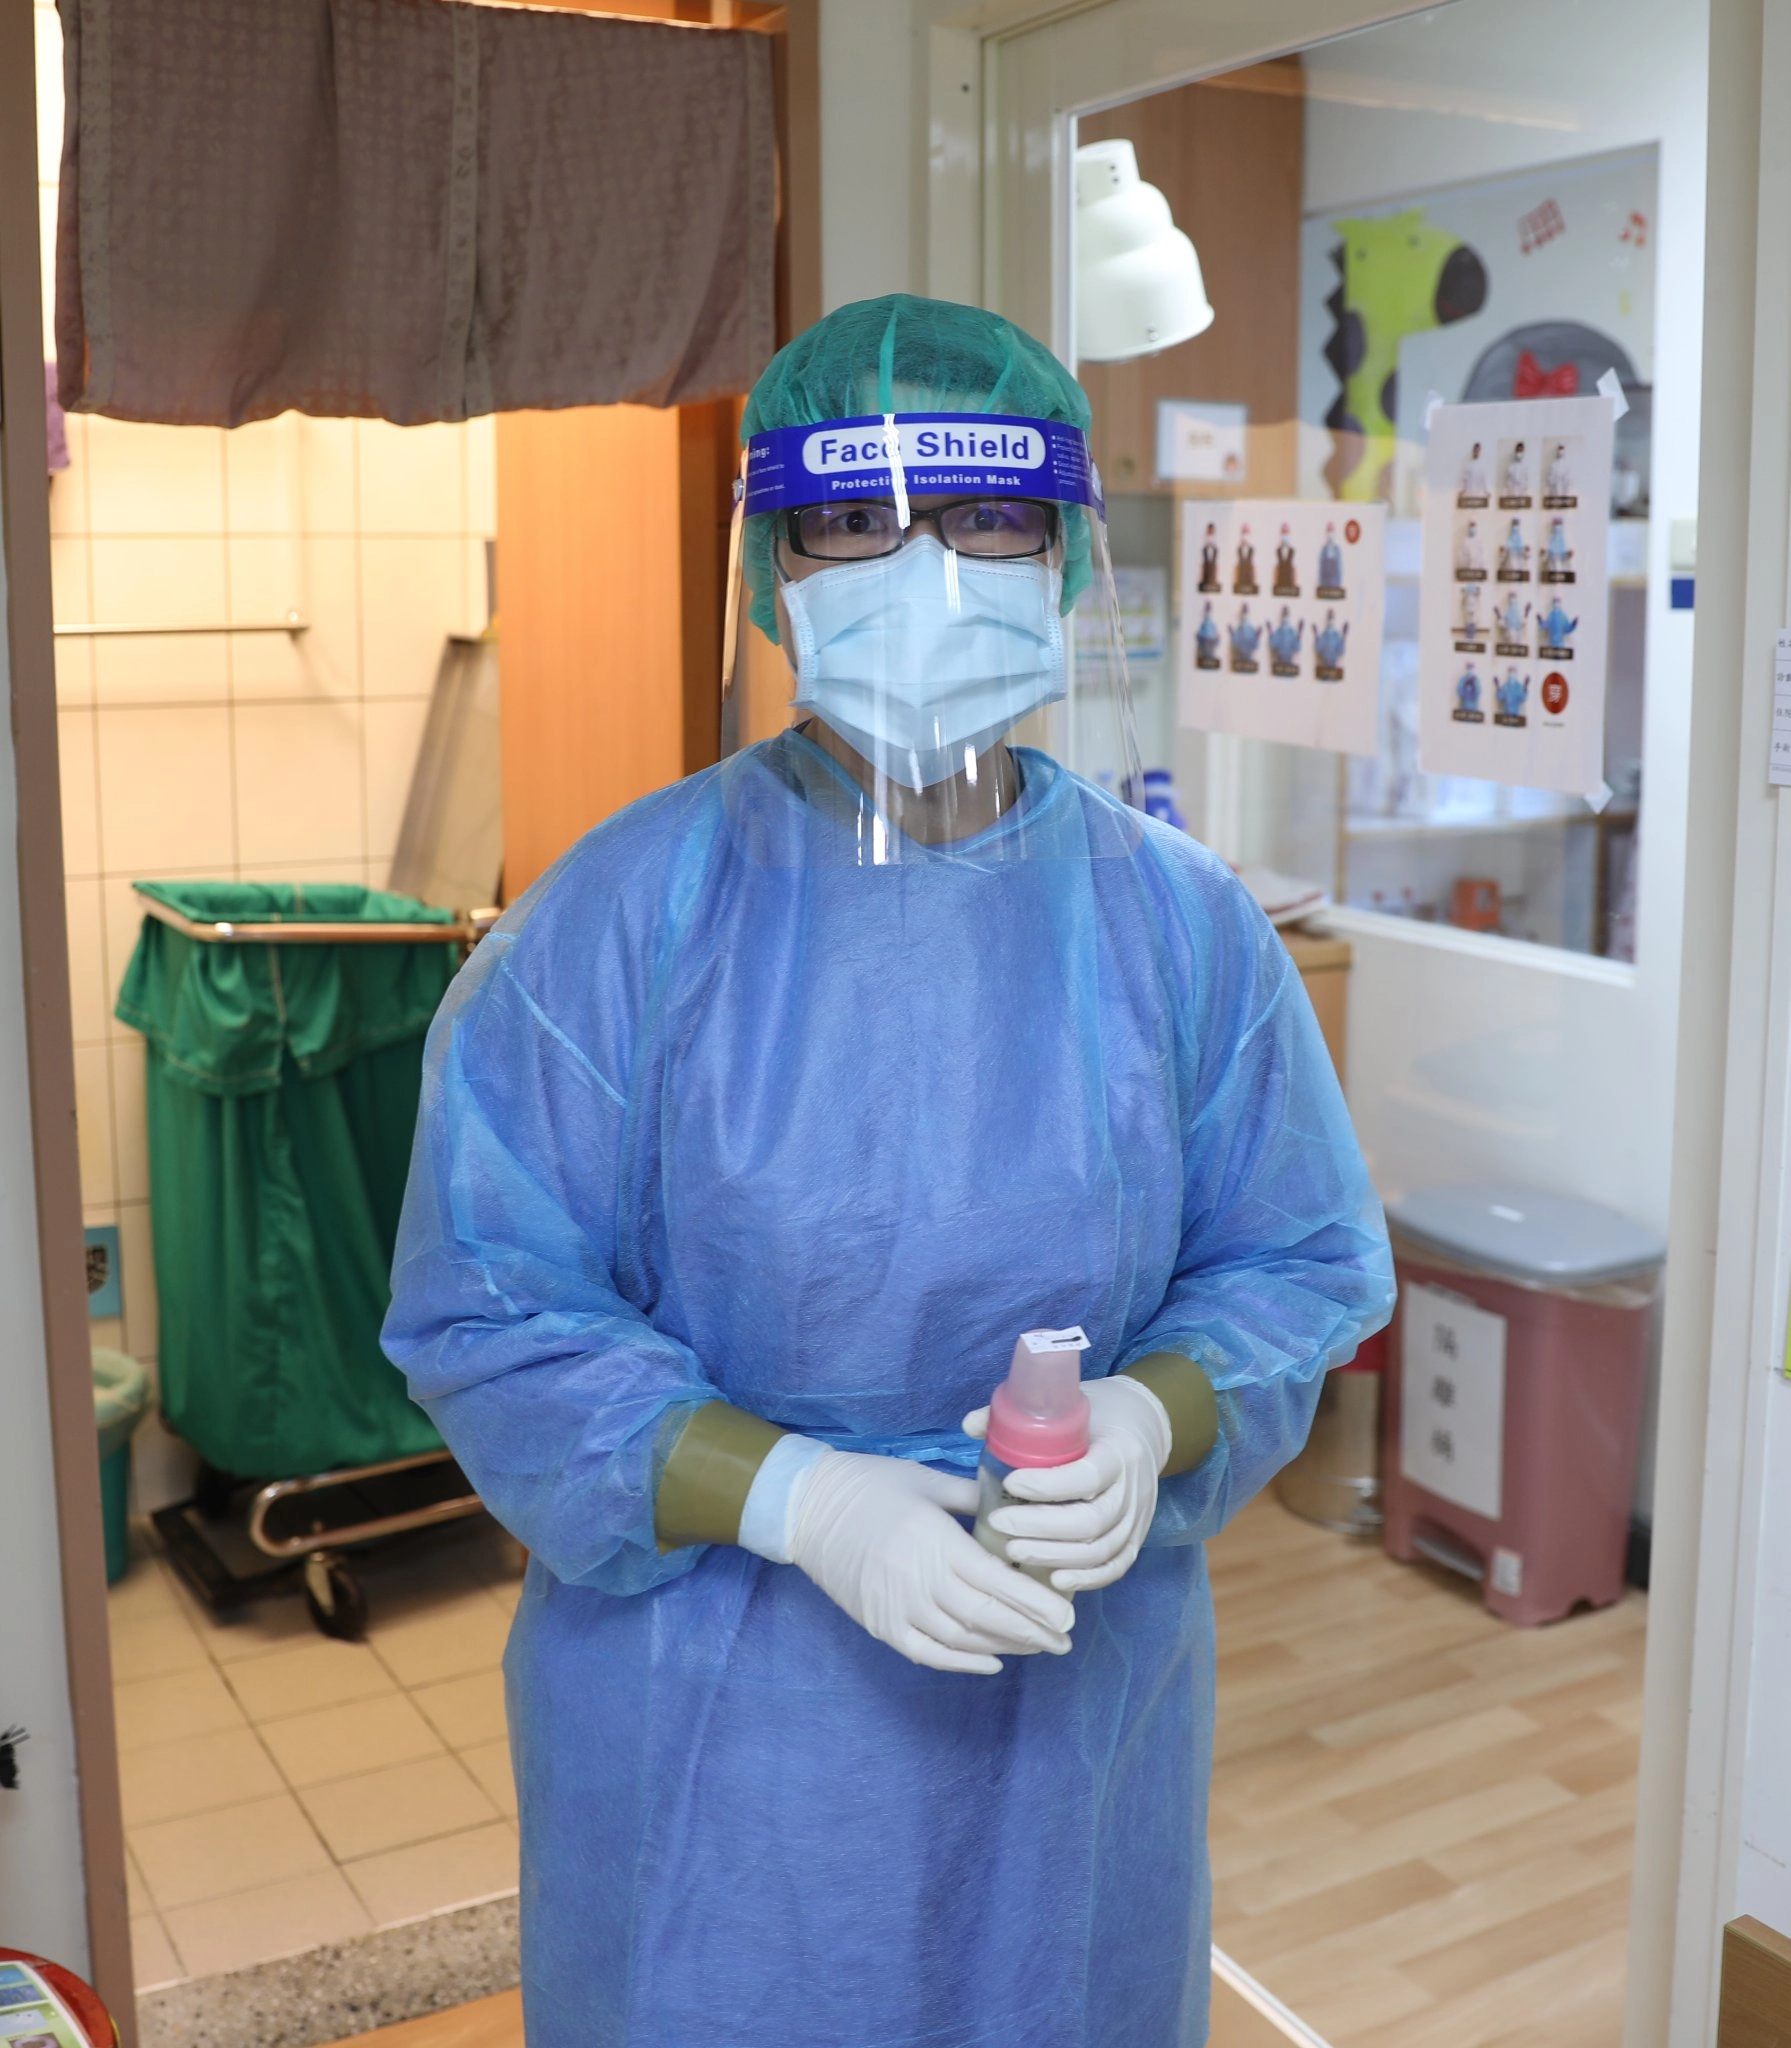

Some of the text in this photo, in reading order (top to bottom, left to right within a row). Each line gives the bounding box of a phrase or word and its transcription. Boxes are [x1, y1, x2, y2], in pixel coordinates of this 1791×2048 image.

[916, 431, 1029, 460] Shield
[831, 473, 1021, 491] Protecti Isolation Mask
